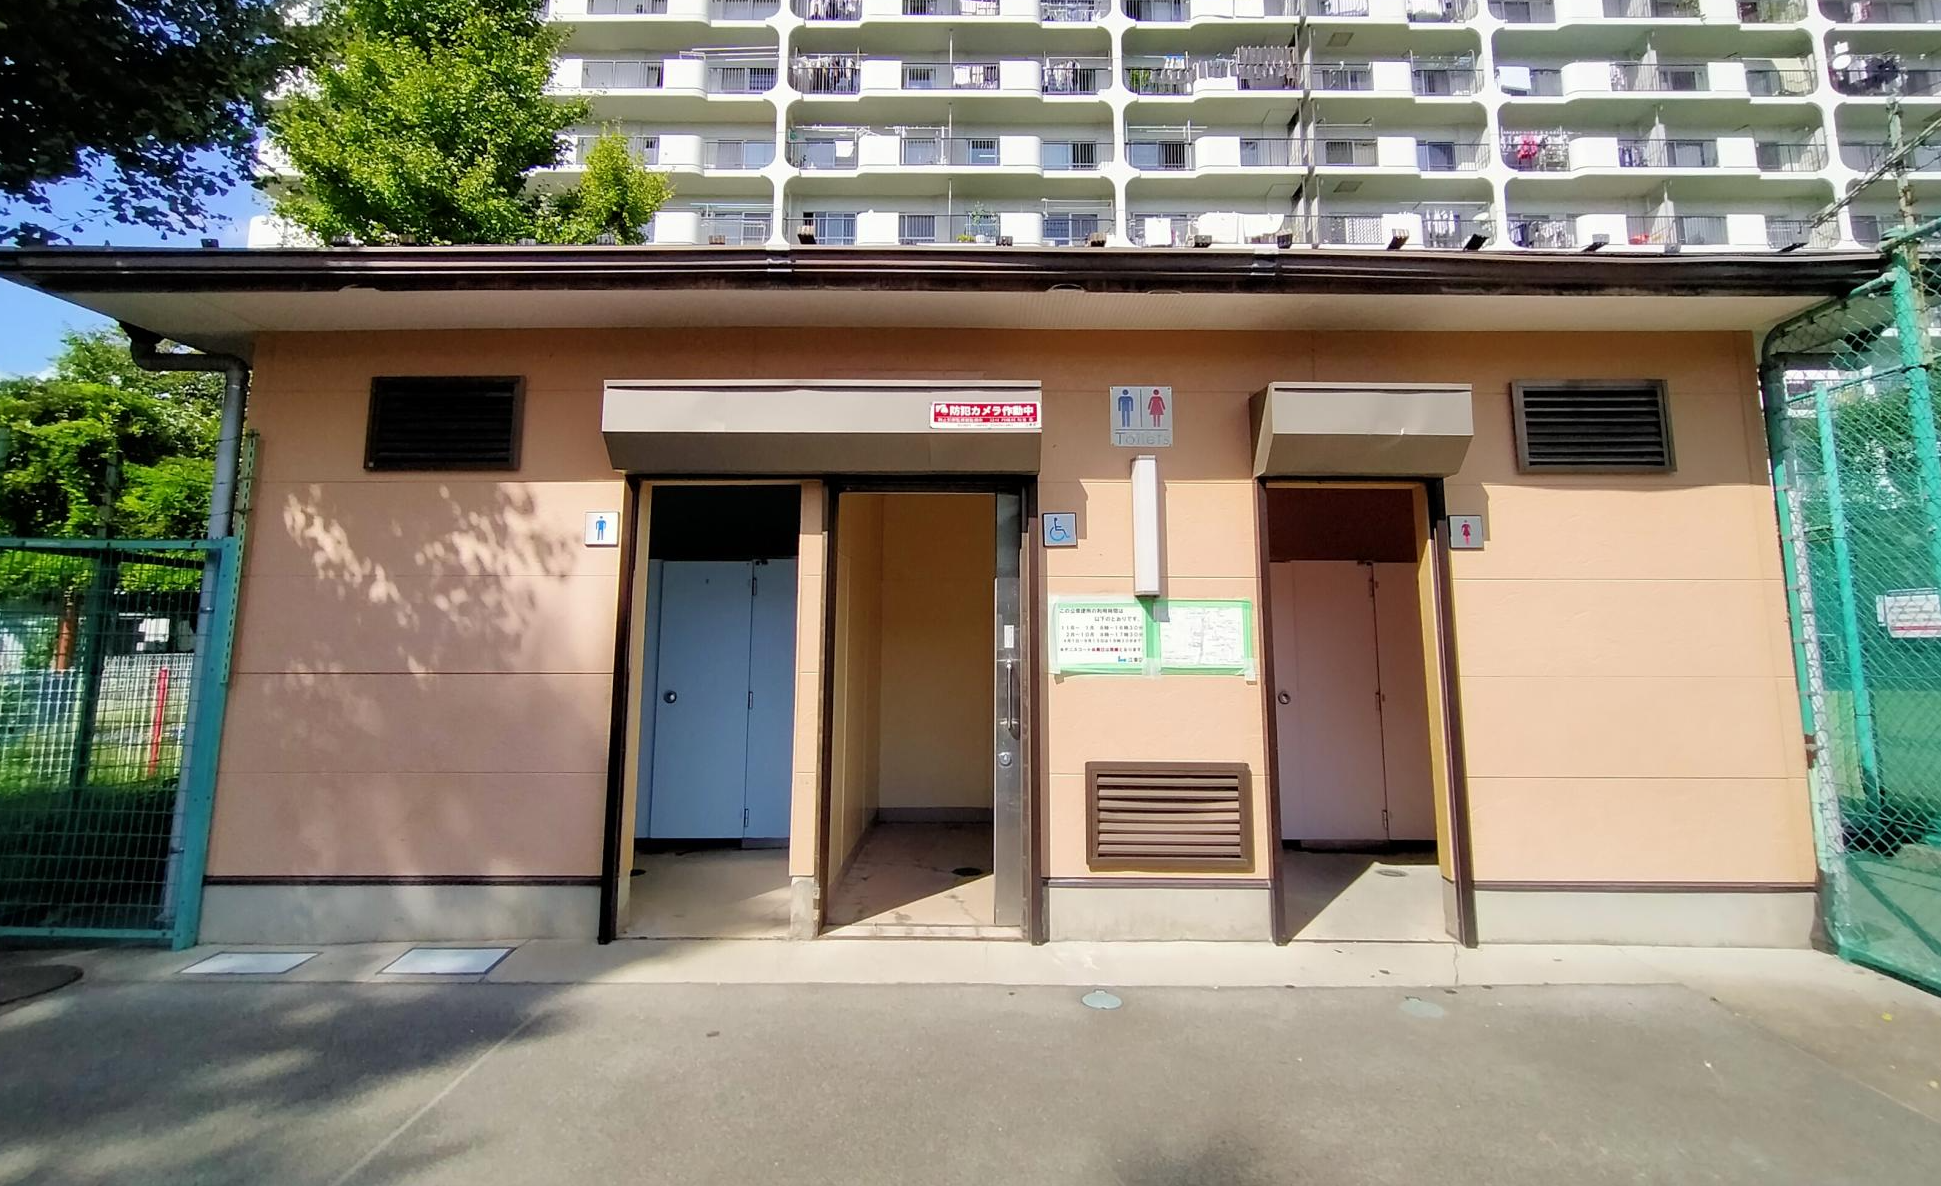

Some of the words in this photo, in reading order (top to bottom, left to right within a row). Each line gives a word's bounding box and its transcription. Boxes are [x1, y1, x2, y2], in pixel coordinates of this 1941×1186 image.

[949, 405, 1034, 416] 防犯カメラ作動中
[1115, 432, 1170, 445] Toilets
